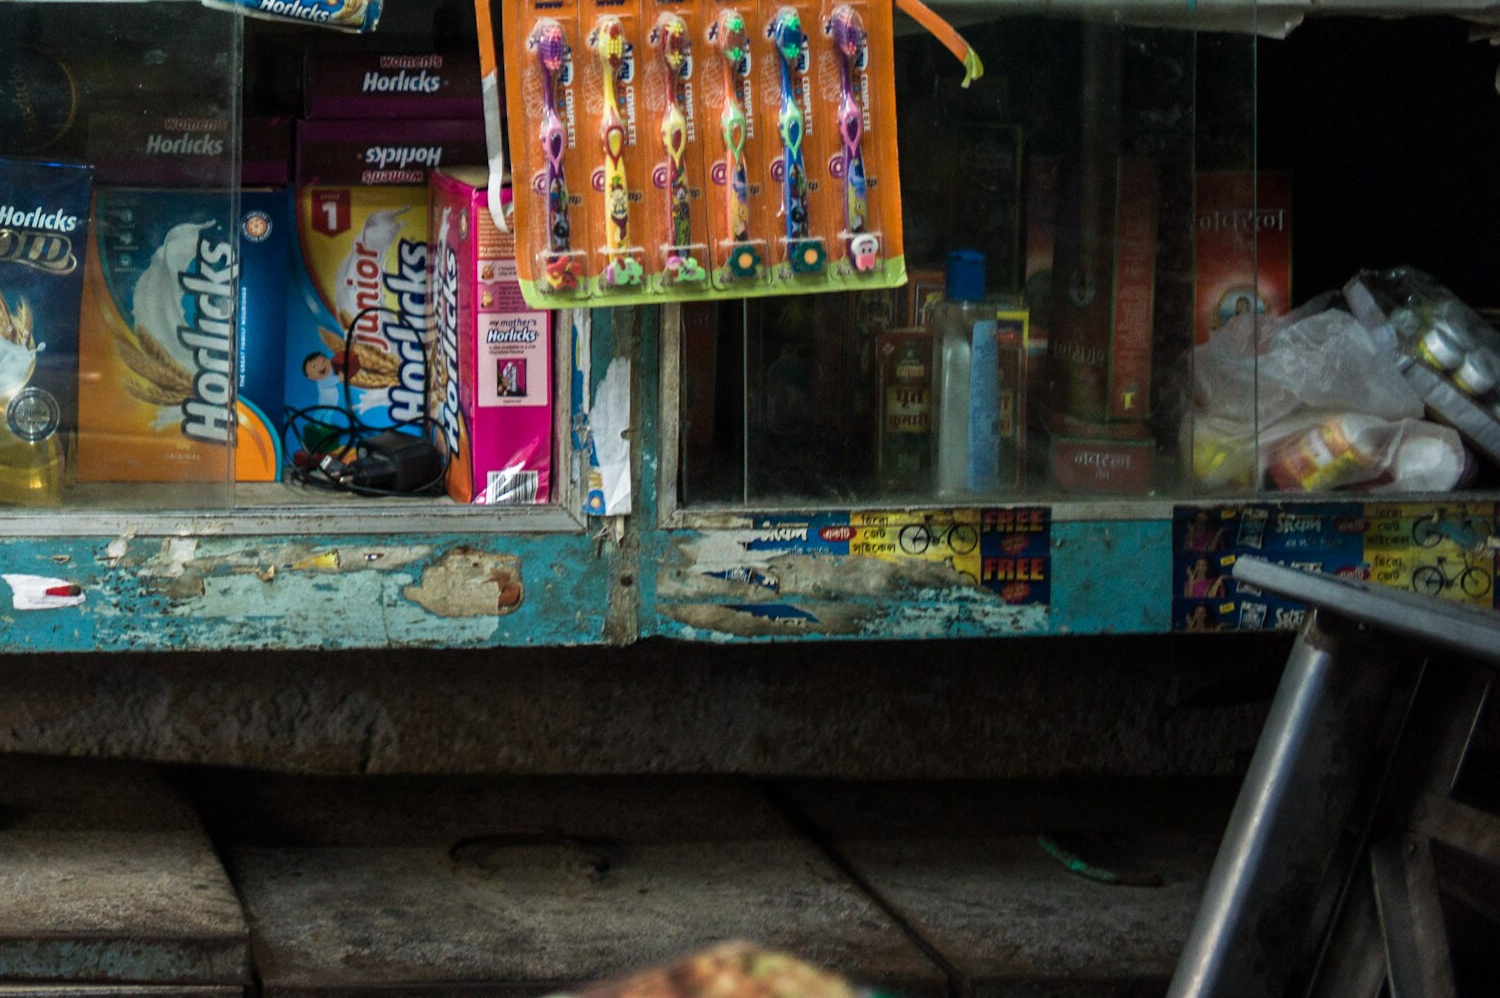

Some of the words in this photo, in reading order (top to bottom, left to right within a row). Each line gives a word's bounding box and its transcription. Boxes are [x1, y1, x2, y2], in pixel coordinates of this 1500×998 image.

[379, 55, 443, 68] women's
[361, 71, 442, 94] Horlicks
[624, 85, 637, 147] COMPLETE
[364, 146, 443, 166] Horlicks
[361, 169, 424, 183] women's
[320, 201, 339, 231] 1
[345, 241, 390, 352] junior
[499, 317, 538, 327] mother's
[182, 240, 239, 446] Horlicks
[384, 239, 430, 438] Horlicks
[487, 328, 537, 343] Horlicks
[983, 557, 1045, 582] FREE
